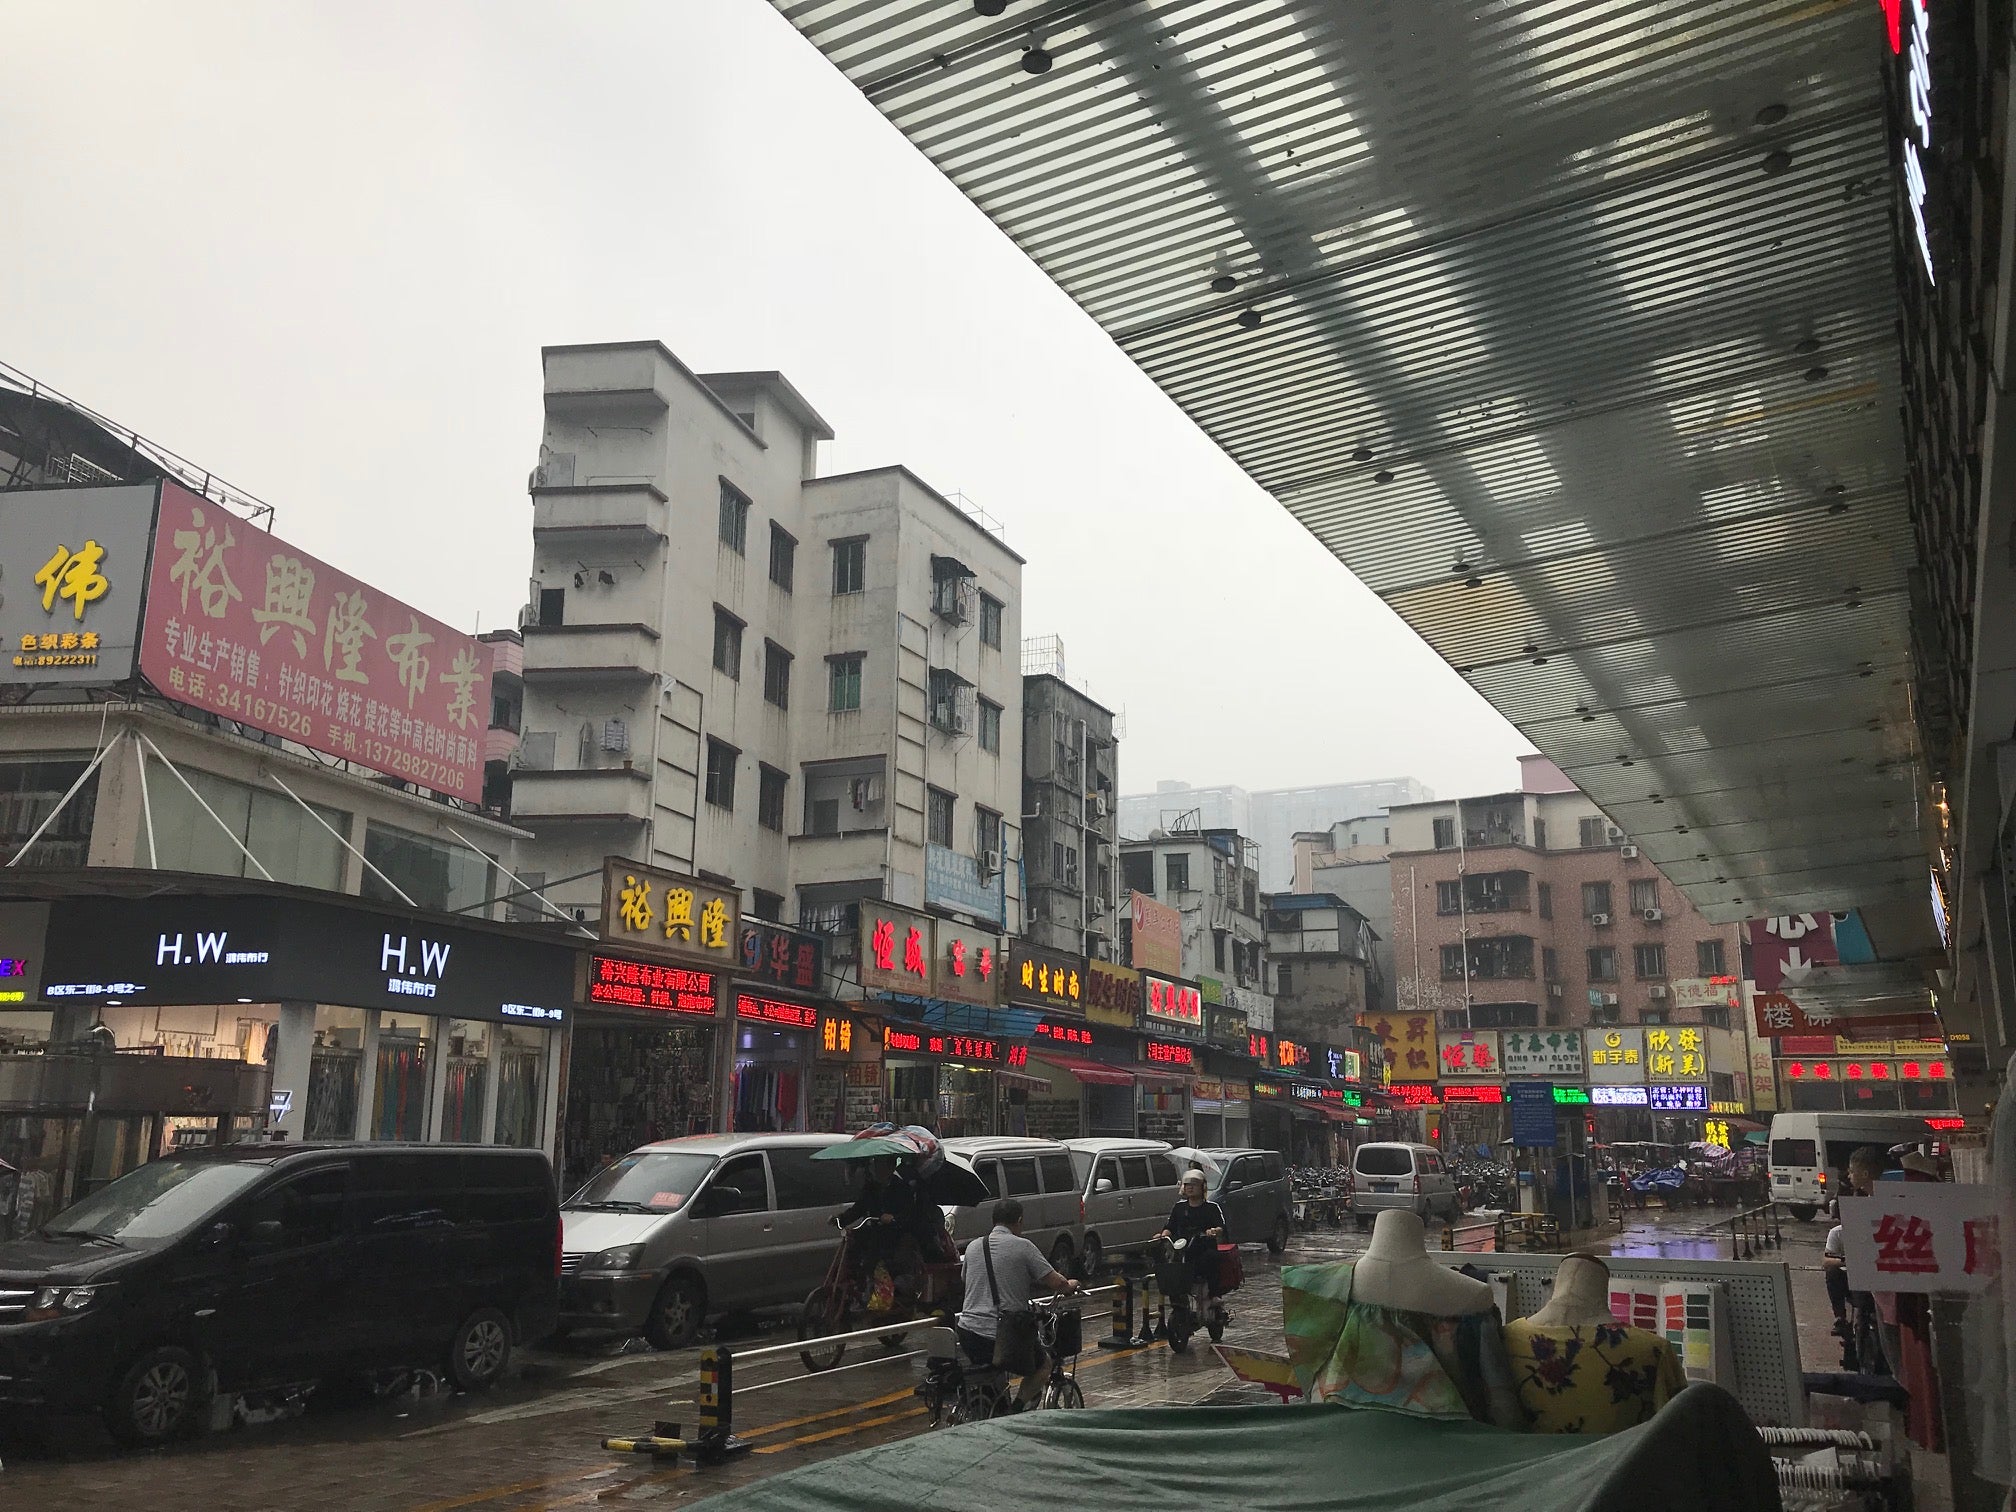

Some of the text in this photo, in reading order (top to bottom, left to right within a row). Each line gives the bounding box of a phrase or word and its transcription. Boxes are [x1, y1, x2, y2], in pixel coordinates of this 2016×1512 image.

[169, 507, 485, 731] 裕興隆布業
[21, 631, 100, 651] 色织彩条
[620, 875, 732, 948] 裕興隆
[157, 932, 228, 965] H.W
[381, 933, 450, 979] H.W
[0, 959, 26, 977] EX
[1592, 1049, 1639, 1065] 新宇泰
